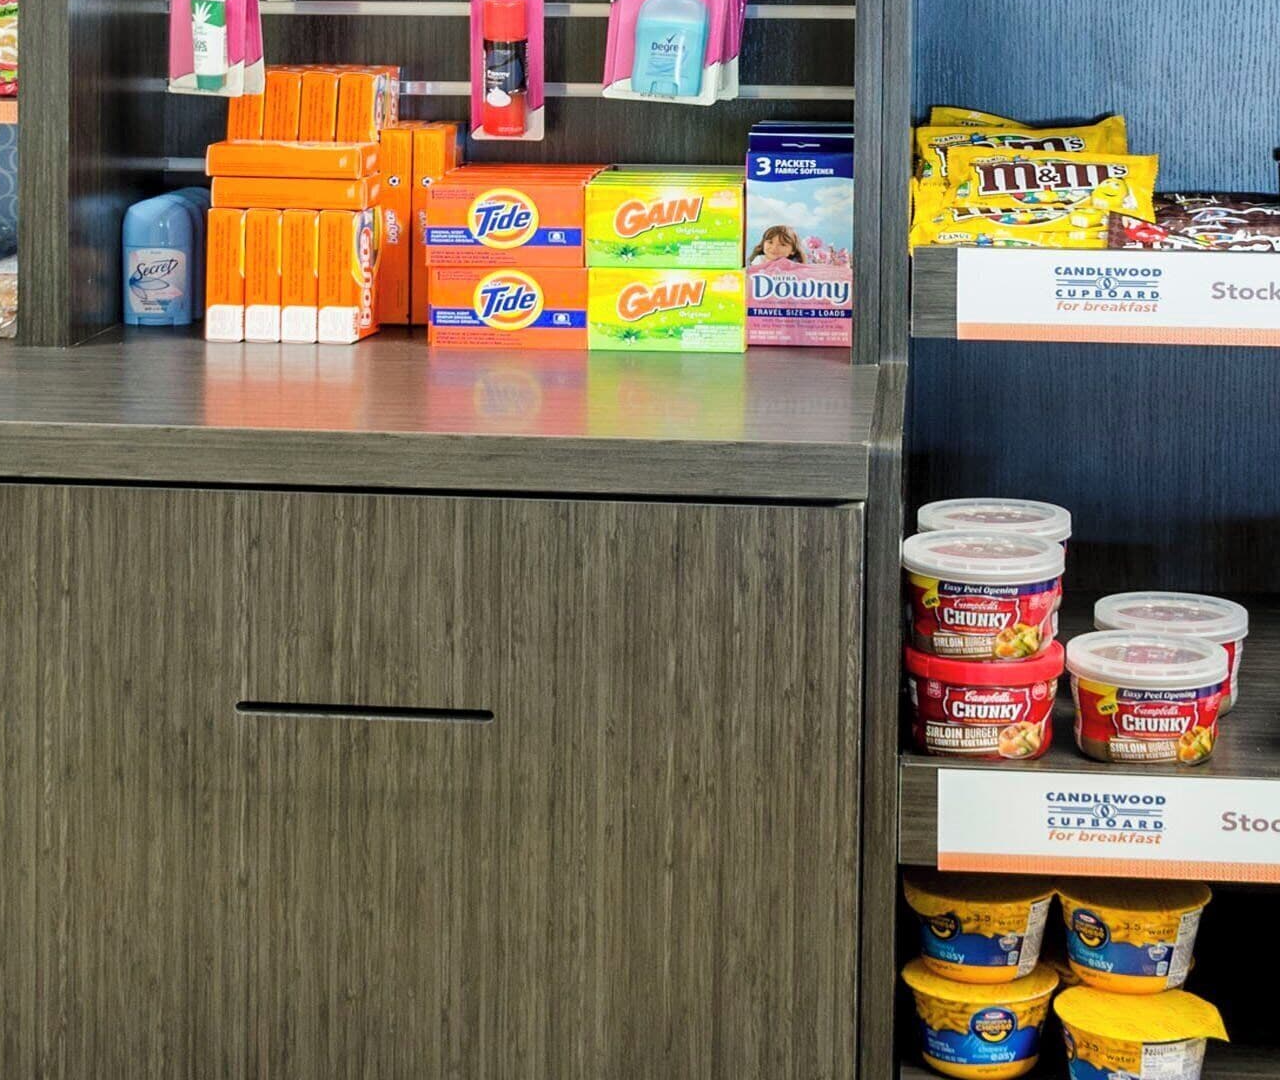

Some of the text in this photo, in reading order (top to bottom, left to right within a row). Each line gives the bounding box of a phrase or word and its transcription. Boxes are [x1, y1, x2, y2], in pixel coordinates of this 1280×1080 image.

[755, 157, 817, 176] 3 PACKETS
[977, 160, 1129, 196] m&m's
[475, 201, 532, 237] Tide
[614, 196, 704, 238] GAIN
[480, 282, 537, 318] Tide
[617, 280, 707, 321] GAIN
[753, 274, 850, 304] Downy
[951, 700, 1023, 721] CHUNKY
[1045, 791, 1167, 806] CANDLEWOOD
[1046, 816, 1164, 830] CUPBOARD
[1047, 828, 1163, 845] for breakfast
